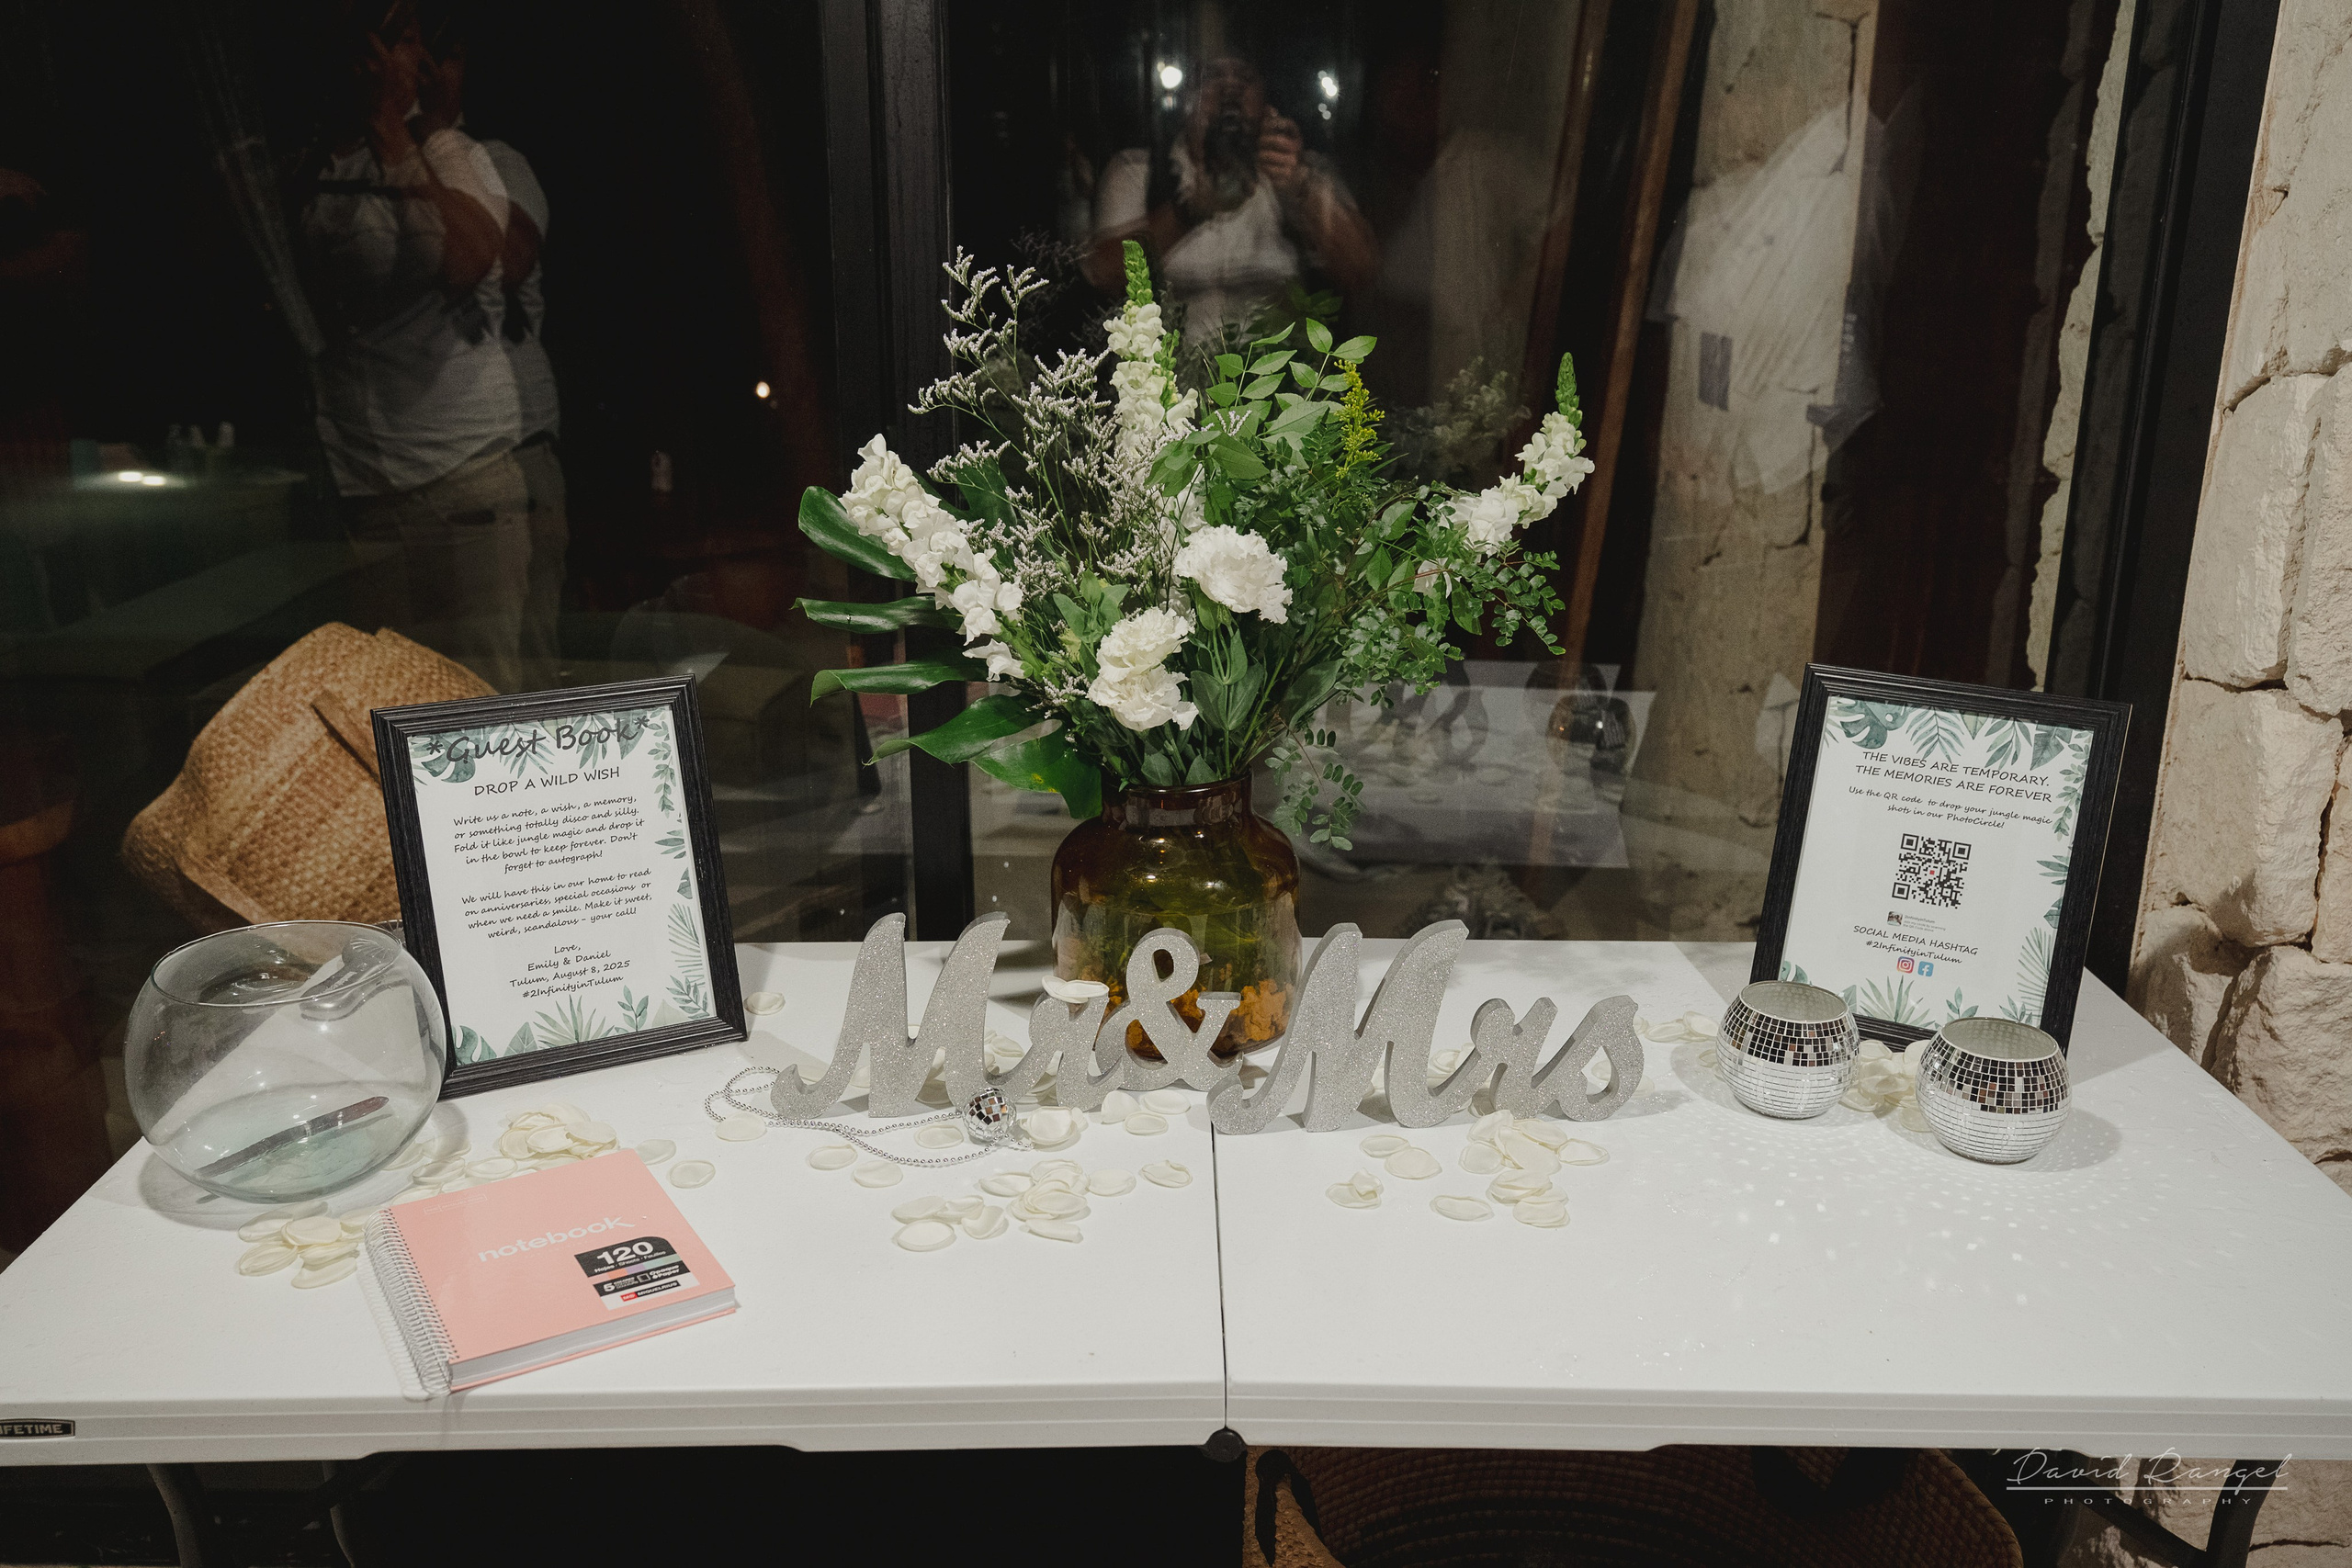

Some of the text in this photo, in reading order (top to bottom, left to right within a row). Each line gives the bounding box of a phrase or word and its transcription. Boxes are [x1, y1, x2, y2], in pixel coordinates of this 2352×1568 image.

[474, 766, 619, 795] DROP A WILD WISH
[1862, 751, 2049, 786] THE VIBES ARE TEMPORARY.
[1855, 765, 2052, 802] THE MEMORIES ARE FOREVER
[453, 816, 483, 826] Write
[511, 808, 537, 817] note,
[550, 802, 580, 812] wish,
[594, 795, 636, 806] memory,
[1849, 785, 1864, 794] Use
[1883, 791, 1897, 800] QR
[1939, 800, 1962, 811] drop
[1963, 806, 1986, 814] your
[1988, 810, 2019, 819] jungle
[2022, 815, 2052, 824] magic
[1887, 804, 1911, 814] shots
[1913, 807, 1925, 815] in
[1946, 813, 2005, 828] PhotoCircle!
[454, 818, 644, 852] Fold it like jungle magic and drop it
[469, 823, 521, 838] something
[525, 818, 558, 829] totally
[561, 815, 589, 824] disco
[591, 809, 612, 819] and
[615, 807, 639, 817] silly.
[466, 856, 479, 864] in
[481, 853, 499, 863] the
[502, 848, 528, 859] bowl
[530, 847, 541, 855] to
[543, 844, 568, 852] keep
[570, 839, 606, 852] forever.
[503, 850, 602, 874] forget to autograph!
[461, 895, 477, 904] We
[479, 891, 502, 901] will
[503, 888, 528, 897] have
[530, 884, 551, 894] this
[553, 882, 566, 890] in
[588, 874, 615, 885] home
[629, 867, 651, 878] read
[481, 897, 550, 914] anniversaries,
[554, 890, 589, 904] special
[591, 885, 636, 897] occasions
[468, 919, 497, 929] when
[515, 909, 540, 920] need
[552, 905, 581, 916] smile.
[584, 900, 612, 909] Make
[614, 897, 623, 905] it
[625, 893, 651, 904] sweet,
[487, 926, 520, 938] weird,
[524, 919, 579, 932] scandalous
[590, 913, 612, 923] your
[615, 907, 636, 917] call!
[554, 944, 581, 953] Love,
[1853, 925, 1978, 955] SOCIAL MEDIA HASHTAG
[1866, 940, 1962, 963] #2InfinityinTulum
[509, 976, 548, 987] Tulum,
[552, 967, 588, 980] August
[603, 959, 630, 971] 2025
[527, 959, 559, 971] Emily
[575, 950, 611, 963] Daniel
[522, 976, 623, 998] #2InfinityinTulum
[1206, 919, 1645, 1134] Mrs
[478, 1214, 636, 1263] notebook
[596, 1241, 654, 1265] 120
[603, 1282, 616, 1292] 5
[0, 1424, 62, 1435] IFETIME
